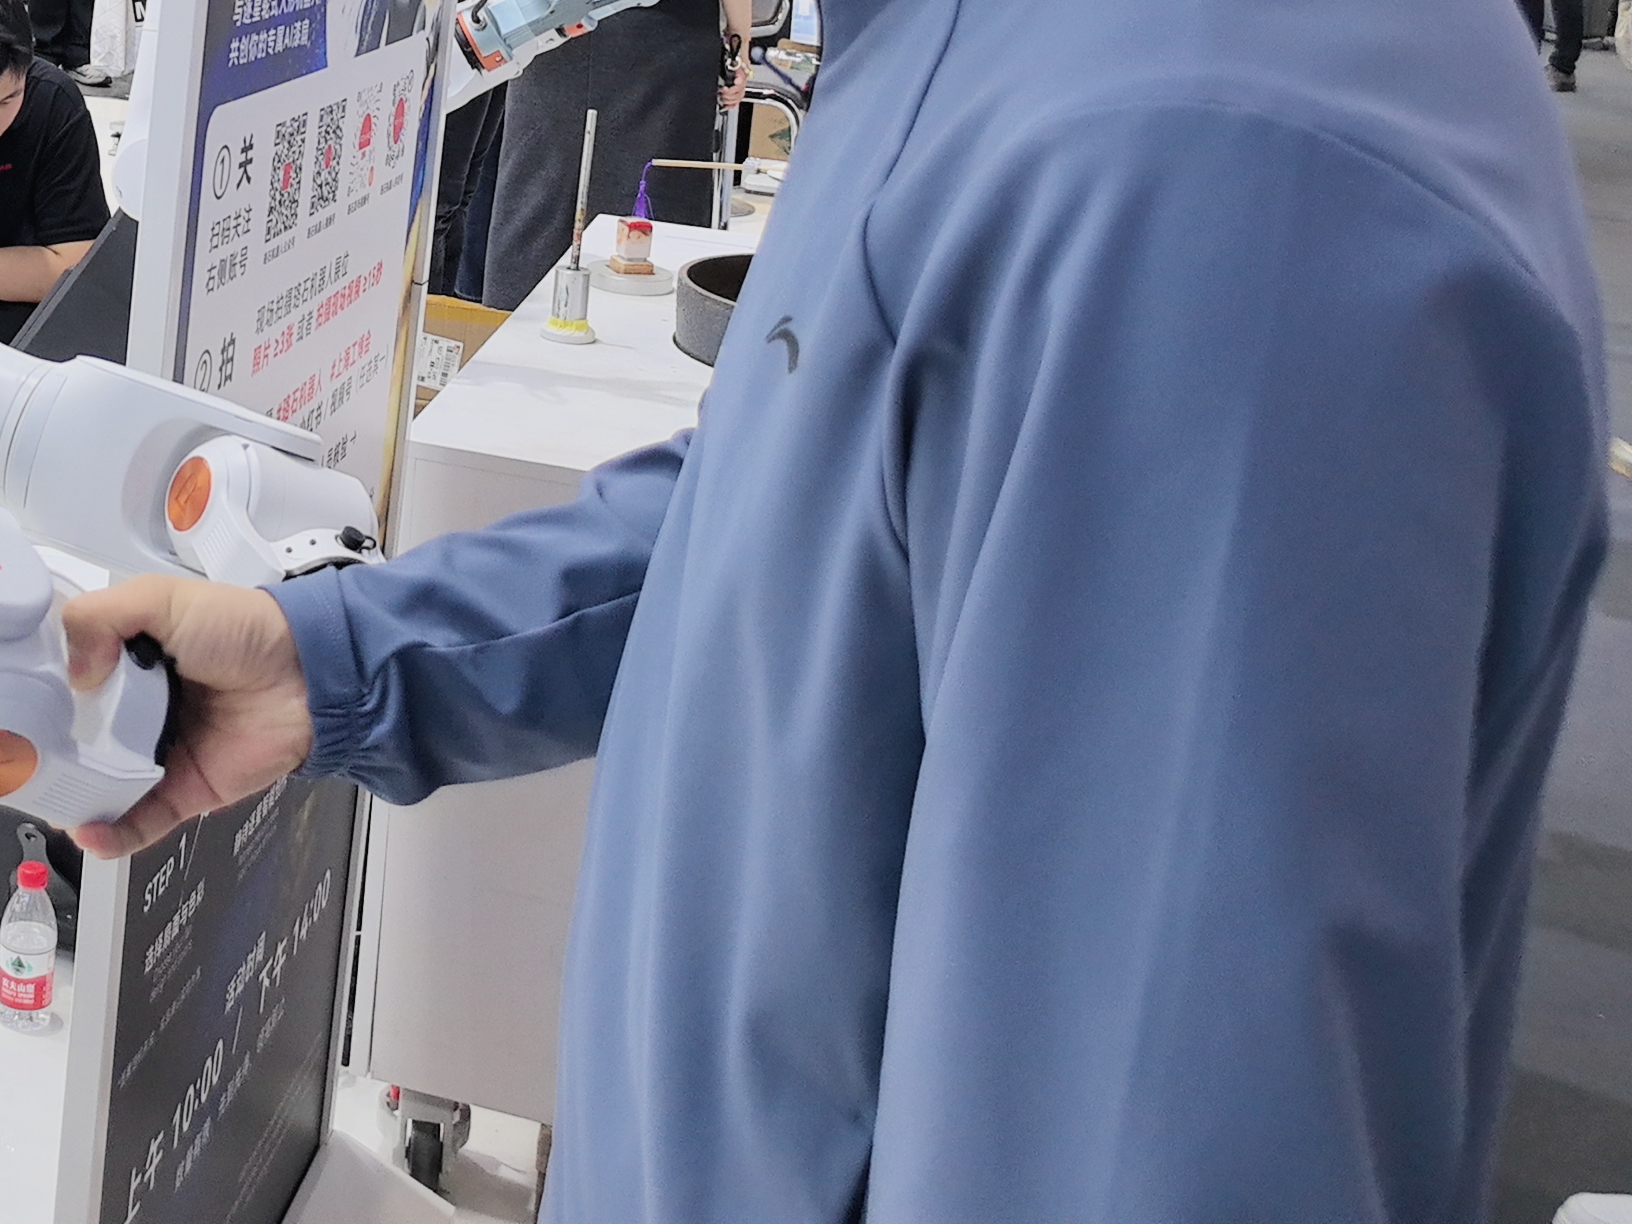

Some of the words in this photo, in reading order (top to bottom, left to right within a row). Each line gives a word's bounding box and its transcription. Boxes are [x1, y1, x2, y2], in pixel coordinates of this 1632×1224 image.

[236, 133, 254, 190] 关
[209, 203, 253, 253] 扫码关注
[205, 245, 249, 296] 右侧账号
[255, 250, 350, 334] 现场拍摄珞石机器人展位
[217, 332, 236, 390] 拍
[143, 847, 175, 913] STEP
[179, 831, 188, 871] 1
[224, 930, 266, 1016] 活动时间
[124, 1130, 165, 1224] 上午
[172, 1038, 224, 1150] 10:00
[259, 936, 288, 1015] 下午
[293, 867, 331, 957] 14:00
